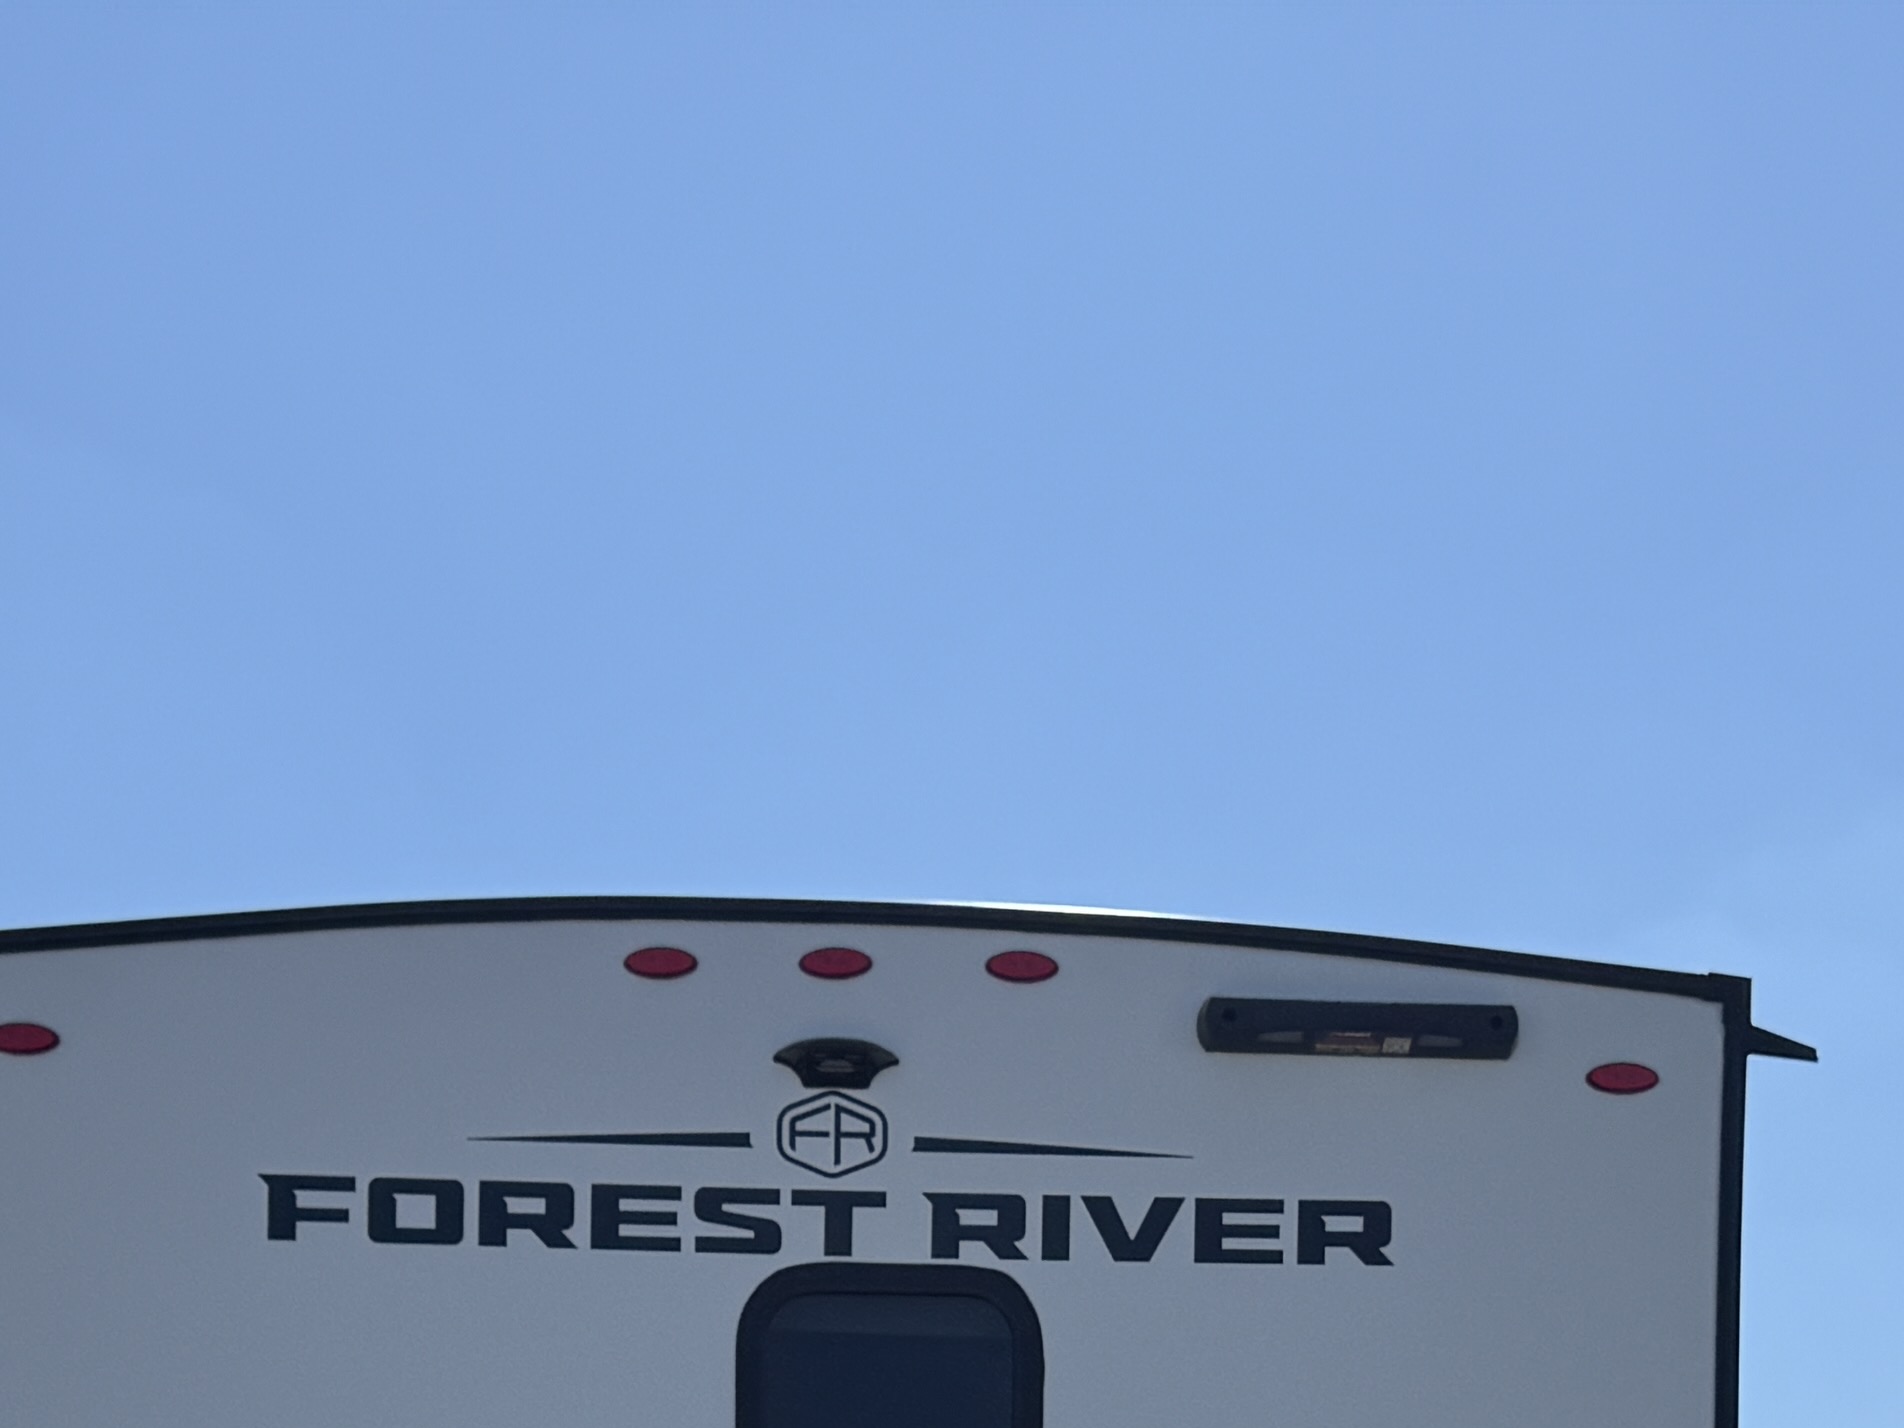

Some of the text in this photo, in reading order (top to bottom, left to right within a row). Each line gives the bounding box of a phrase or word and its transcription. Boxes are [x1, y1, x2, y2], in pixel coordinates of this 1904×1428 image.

[788, 1102, 877, 1166] FR
[257, 1173, 1395, 1267] FOREST RIVER
